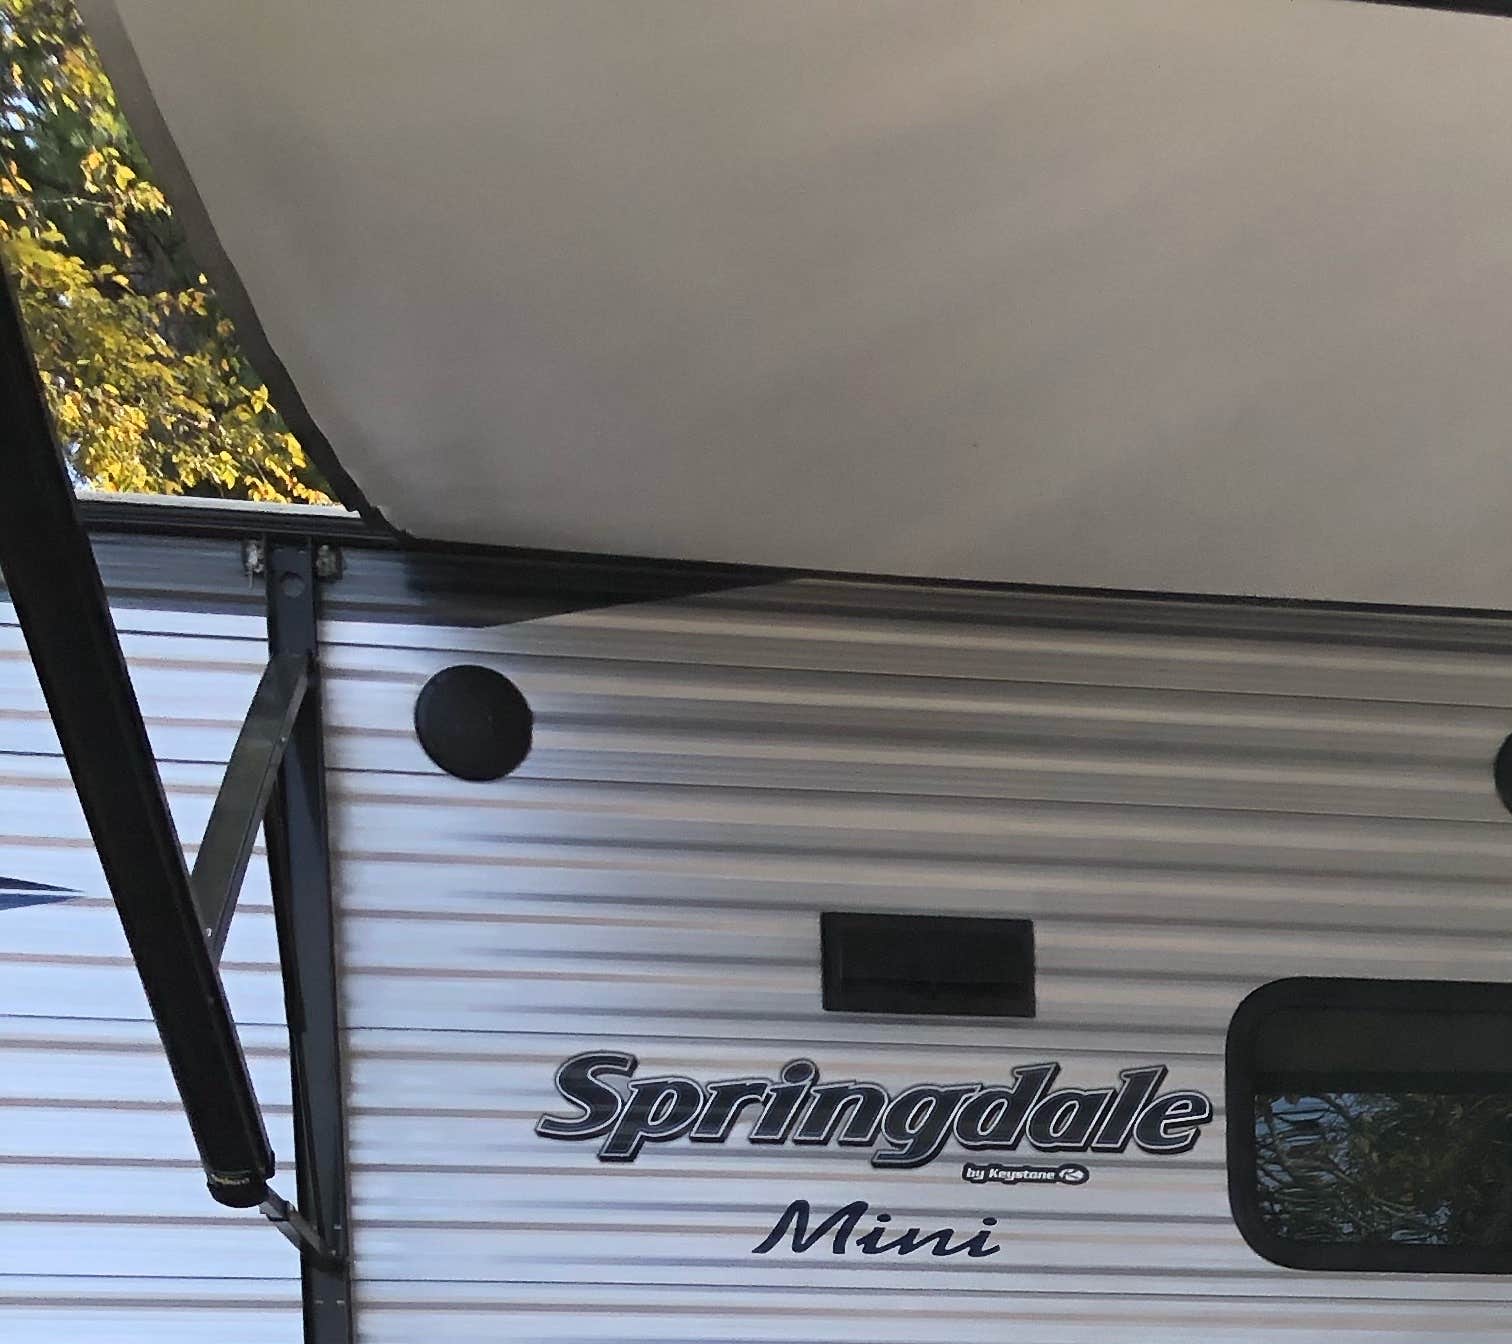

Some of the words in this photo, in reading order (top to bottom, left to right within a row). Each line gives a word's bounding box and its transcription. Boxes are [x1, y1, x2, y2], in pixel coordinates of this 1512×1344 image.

[536, 1050, 1212, 1167] Springdale
[965, 1167, 985, 1181] by
[988, 1167, 1056, 1182] Keystone
[752, 1200, 1000, 1257] Mini
